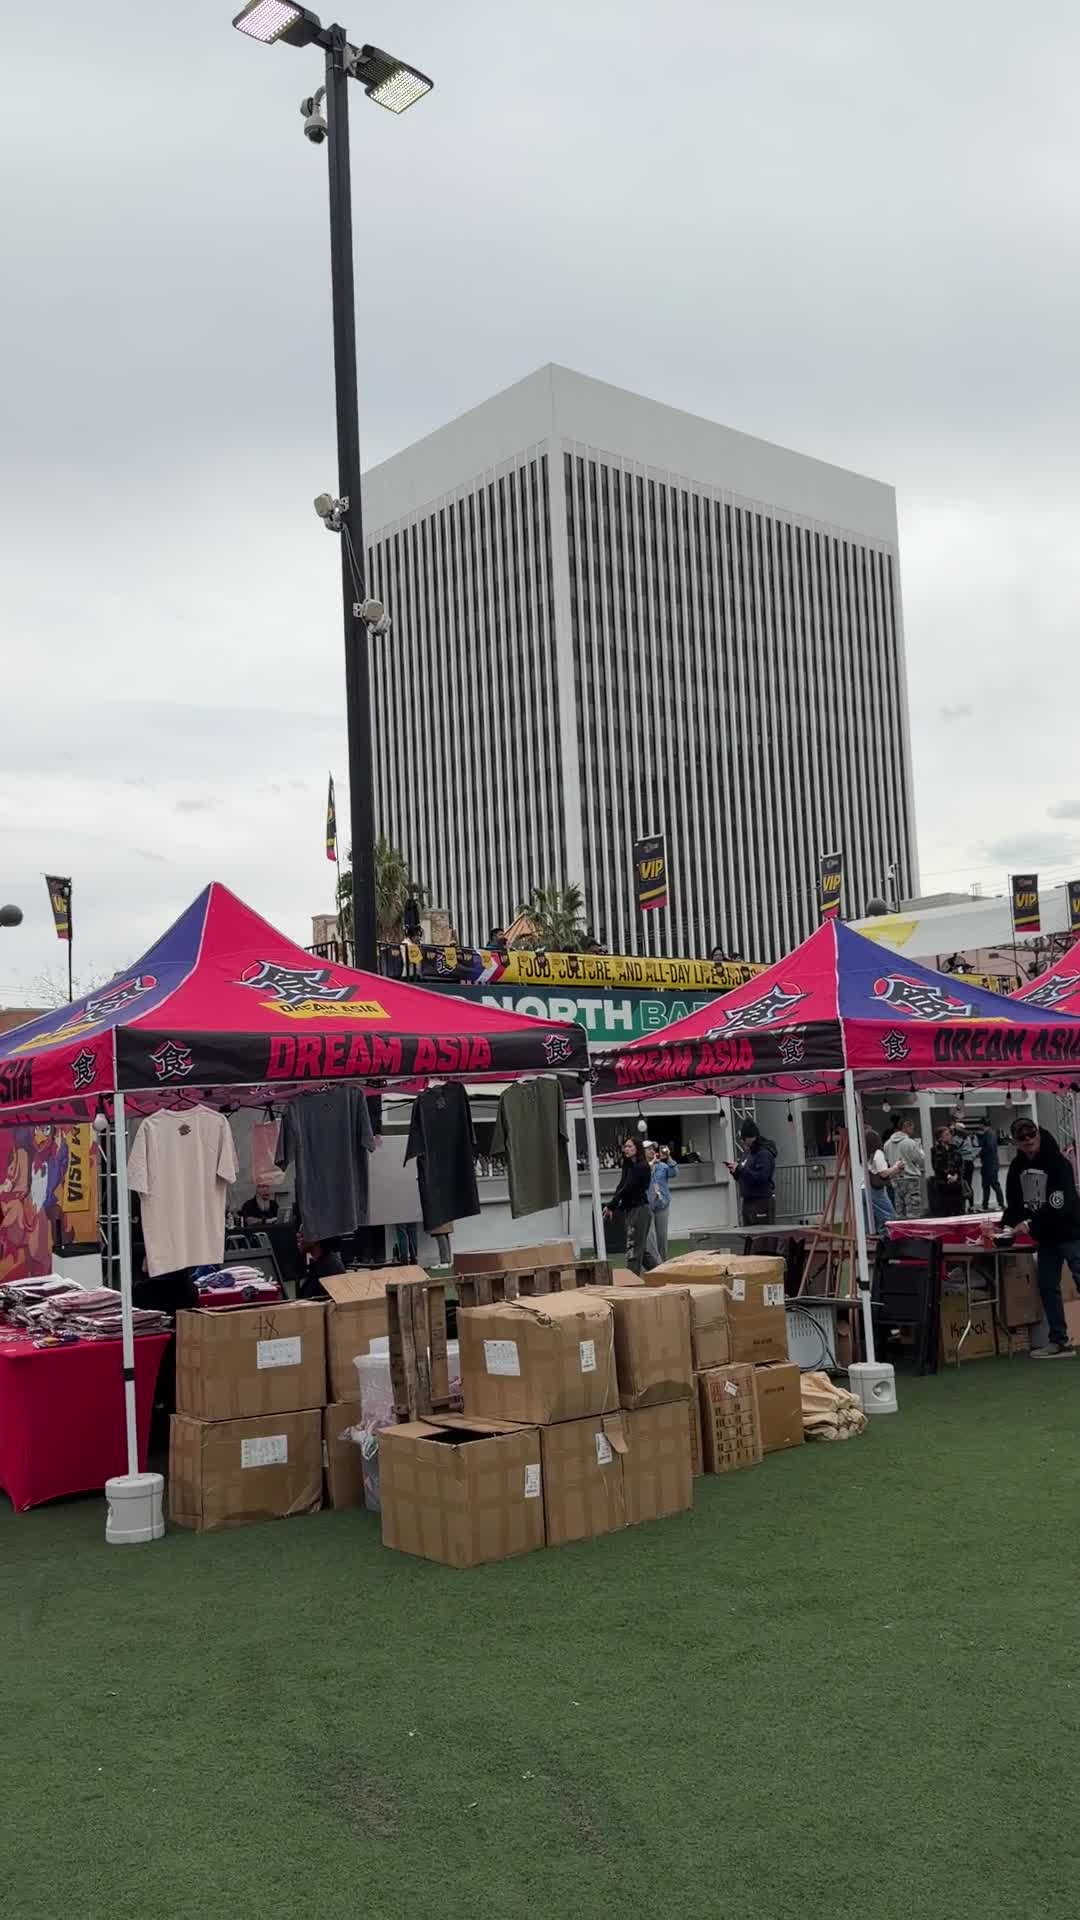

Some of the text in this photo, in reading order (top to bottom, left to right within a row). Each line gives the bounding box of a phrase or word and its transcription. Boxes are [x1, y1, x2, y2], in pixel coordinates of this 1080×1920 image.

[640, 858, 664, 880] VIP
[823, 874, 841, 891] VIP
[1016, 893, 1037, 908] VIP
[280, 1003, 380, 1013] DREAM ASIA
[640, 1000, 710, 1031] BA
[266, 1036, 492, 1079] DREAM ASIA
[934, 1027, 1027, 1062] DREAM
[615, 1037, 755, 1087] DREAM ASIA
[68, 1151, 83, 1202] ASIA
